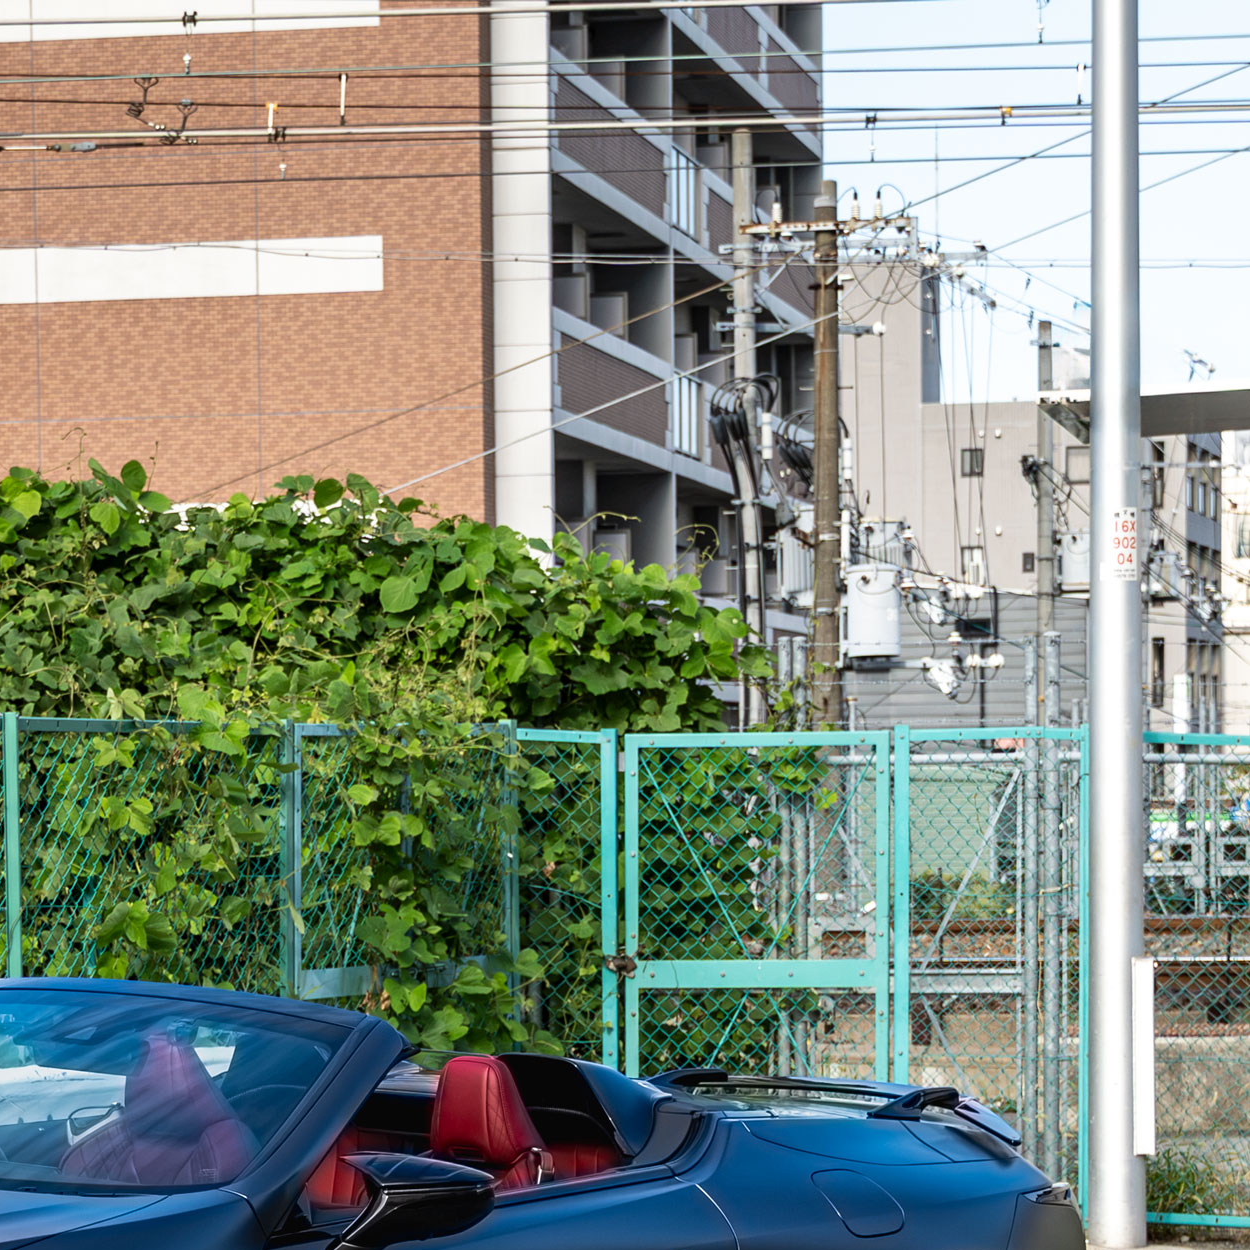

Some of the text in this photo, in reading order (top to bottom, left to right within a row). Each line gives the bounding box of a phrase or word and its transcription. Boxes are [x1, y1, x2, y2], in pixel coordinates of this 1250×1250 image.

[1115, 520, 1136, 533] 16X
[1113, 536, 1136, 549] 902
[1117, 553, 1133, 565] 04
